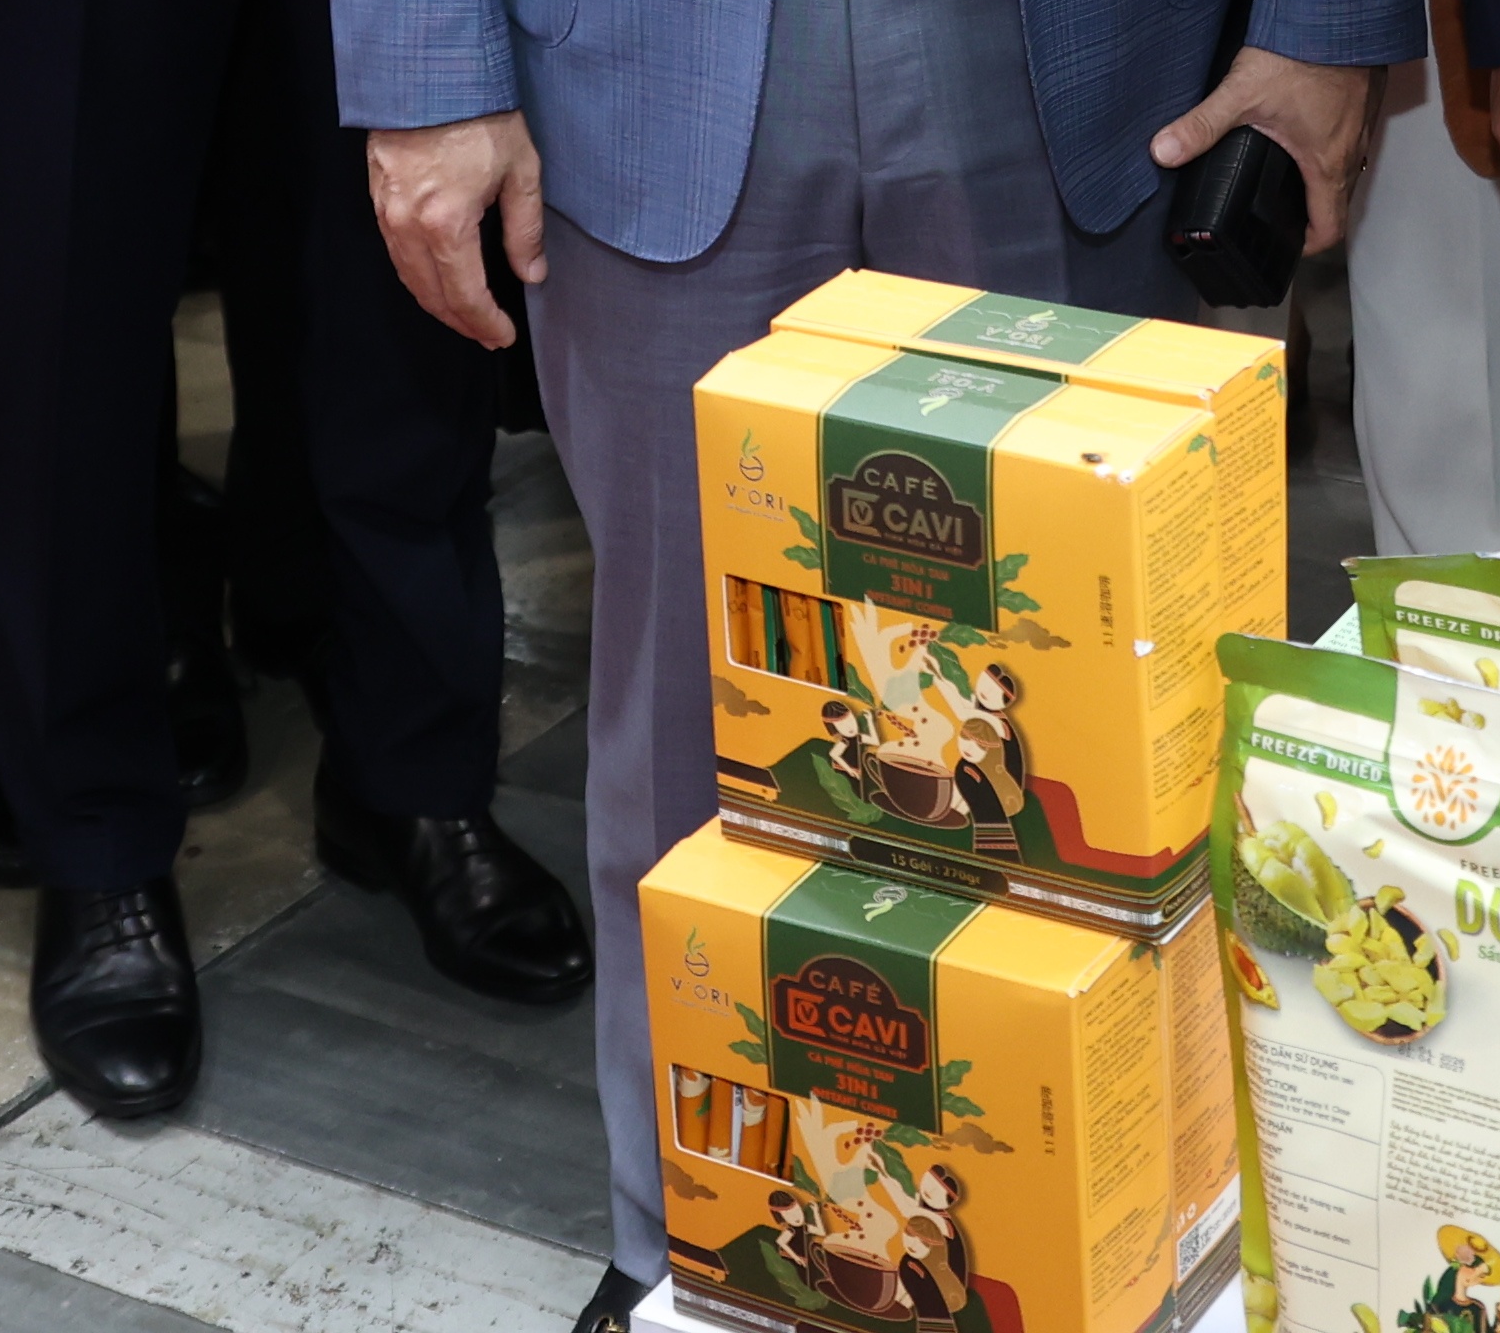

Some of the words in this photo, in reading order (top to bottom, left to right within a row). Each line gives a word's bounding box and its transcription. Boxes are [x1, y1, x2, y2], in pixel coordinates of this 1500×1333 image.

[863, 467, 938, 499] CAFÉ
[882, 503, 963, 545] CAVI
[1396, 609, 1470, 636] FREEZE
[1250, 732, 1319, 768] FREEZE
[1326, 751, 1383, 783] DRIED
[808, 970, 882, 1005] CAFÉ
[828, 1005, 909, 1050] CAVI
